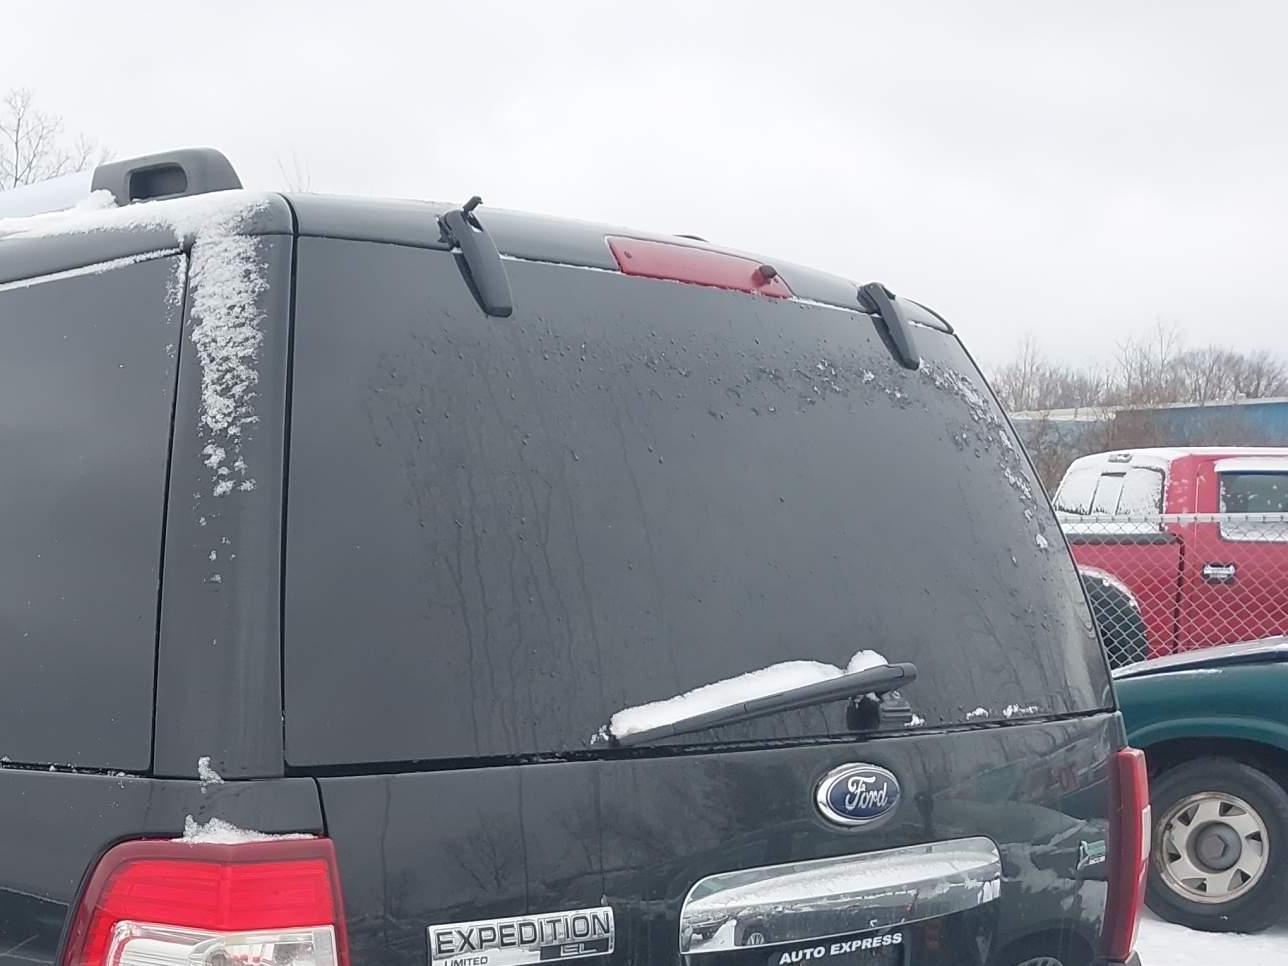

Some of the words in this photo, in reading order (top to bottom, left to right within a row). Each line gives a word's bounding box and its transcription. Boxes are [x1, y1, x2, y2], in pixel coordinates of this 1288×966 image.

[845, 775, 888, 811] Ford
[436, 911, 610, 954] EXPEDITION
[561, 943, 598, 955] EL
[779, 946, 826, 965] AUTO
[830, 932, 903, 957] EXPRESS
